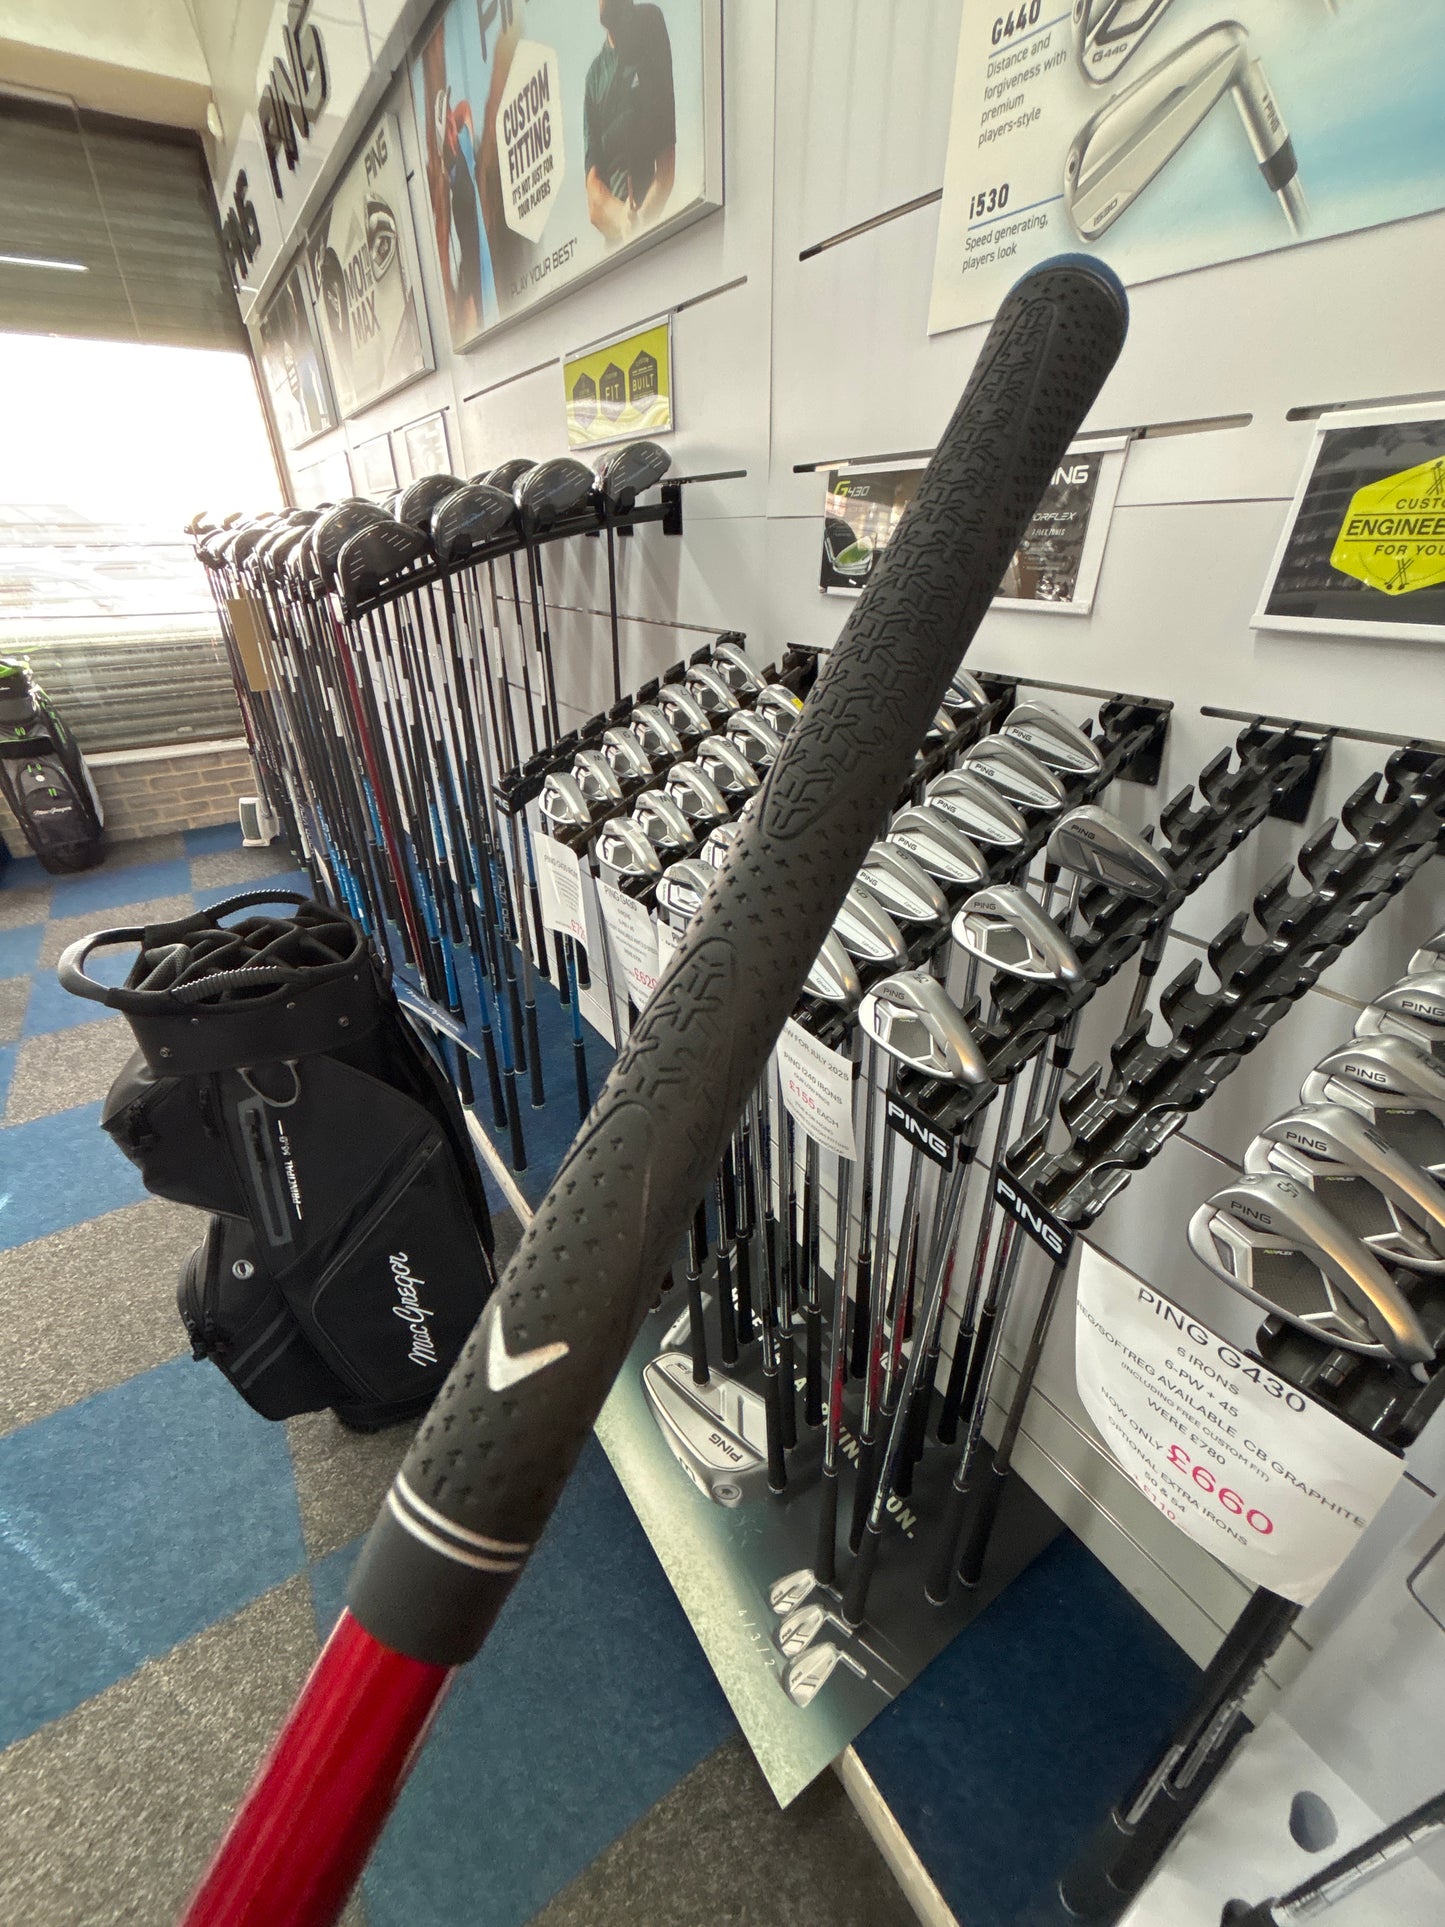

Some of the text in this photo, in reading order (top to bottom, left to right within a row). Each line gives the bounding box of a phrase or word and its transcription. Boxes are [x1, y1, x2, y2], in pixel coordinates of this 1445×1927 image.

[992, 0, 1041, 45] G440
[987, 32, 1051, 79] Distance and
[1092, 43, 1128, 63] G440
[984, 49, 1067, 101] forgiveness with
[503, 61, 550, 146] CUSTOM
[981, 93, 1025, 126] premium
[508, 110, 551, 185] FITTING
[978, 106, 1041, 148] players-style
[364, 128, 389, 187] PING
[521, 175, 531, 197] NOT
[531, 164, 543, 187] JUST
[543, 154, 554, 177] FOR
[518, 179, 551, 220] TOUR PLAYERS
[969, 183, 1010, 220] i530
[965, 213, 1048, 252] Speed generating,
[510, 272, 529, 297] PLAY
[529, 256, 551, 286] YOUR
[962, 241, 1018, 274] players look
[352, 290, 381, 349] MAX
[605, 384, 620, 403] FIT
[632, 374, 655, 391] BUILT
[834, 480, 870, 498] G430
[1051, 465, 1090, 485] ING
[1374, 544, 1408, 556] FOR
[1012, 728, 1032, 742] PING
[975, 763, 995, 777] PING
[936, 799, 956, 814] PING
[898, 837, 918, 851] PING
[1071, 824, 1096, 840] PING
[860, 871, 878, 887] PING
[973, 901, 996, 911] PING
[883, 987, 905, 1000] PING
[1402, 1000, 1445, 1017] PING
[784, 1051, 801, 1071] PING
[817, 1081, 842, 1105] IRONS
[827, 1063, 849, 1082] 2025
[1344, 1064, 1387, 1084] PING
[789, 1079, 815, 1110] £155
[816, 1107, 839, 1128] EACH
[888, 1100, 947, 1158] PING
[1286, 1131, 1328, 1152] PING
[284, 1160, 302, 1204] PRINCIPAL
[996, 1178, 1063, 1255] PING
[1230, 1200, 1272, 1226] PING
[389, 1251, 438, 1367] MacGregor
[1137, 1288, 1306, 1413] PING G430
[1177, 1346, 1240, 1396] 6 IRONS
[1165, 1359, 1205, 1391] 6-PW
[1218, 1401, 1239, 1418] 45
[1121, 1361, 1175, 1407] (INCLUDING
[1176, 1405, 1201, 1428] FREE
[1202, 1426, 1248, 1465] CUSTOM
[1147, 1397, 1226, 1465] WERE £780
[709, 1432, 744, 1463] PING
[1101, 1386, 1128, 1419] NOW
[1129, 1419, 1163, 1451] ONLY
[1167, 1444, 1274, 1535] £660
[1157, 1375, 1238, 1439] AVAILABLE
[1244, 1439, 1268, 1462] CB
[1271, 1461, 1367, 1528] GRAPHITE
[1108, 1415, 1158, 1474] OPTIONAL
[1160, 1472, 1201, 1509] EXTRA
[1202, 1508, 1248, 1546] IRONS
